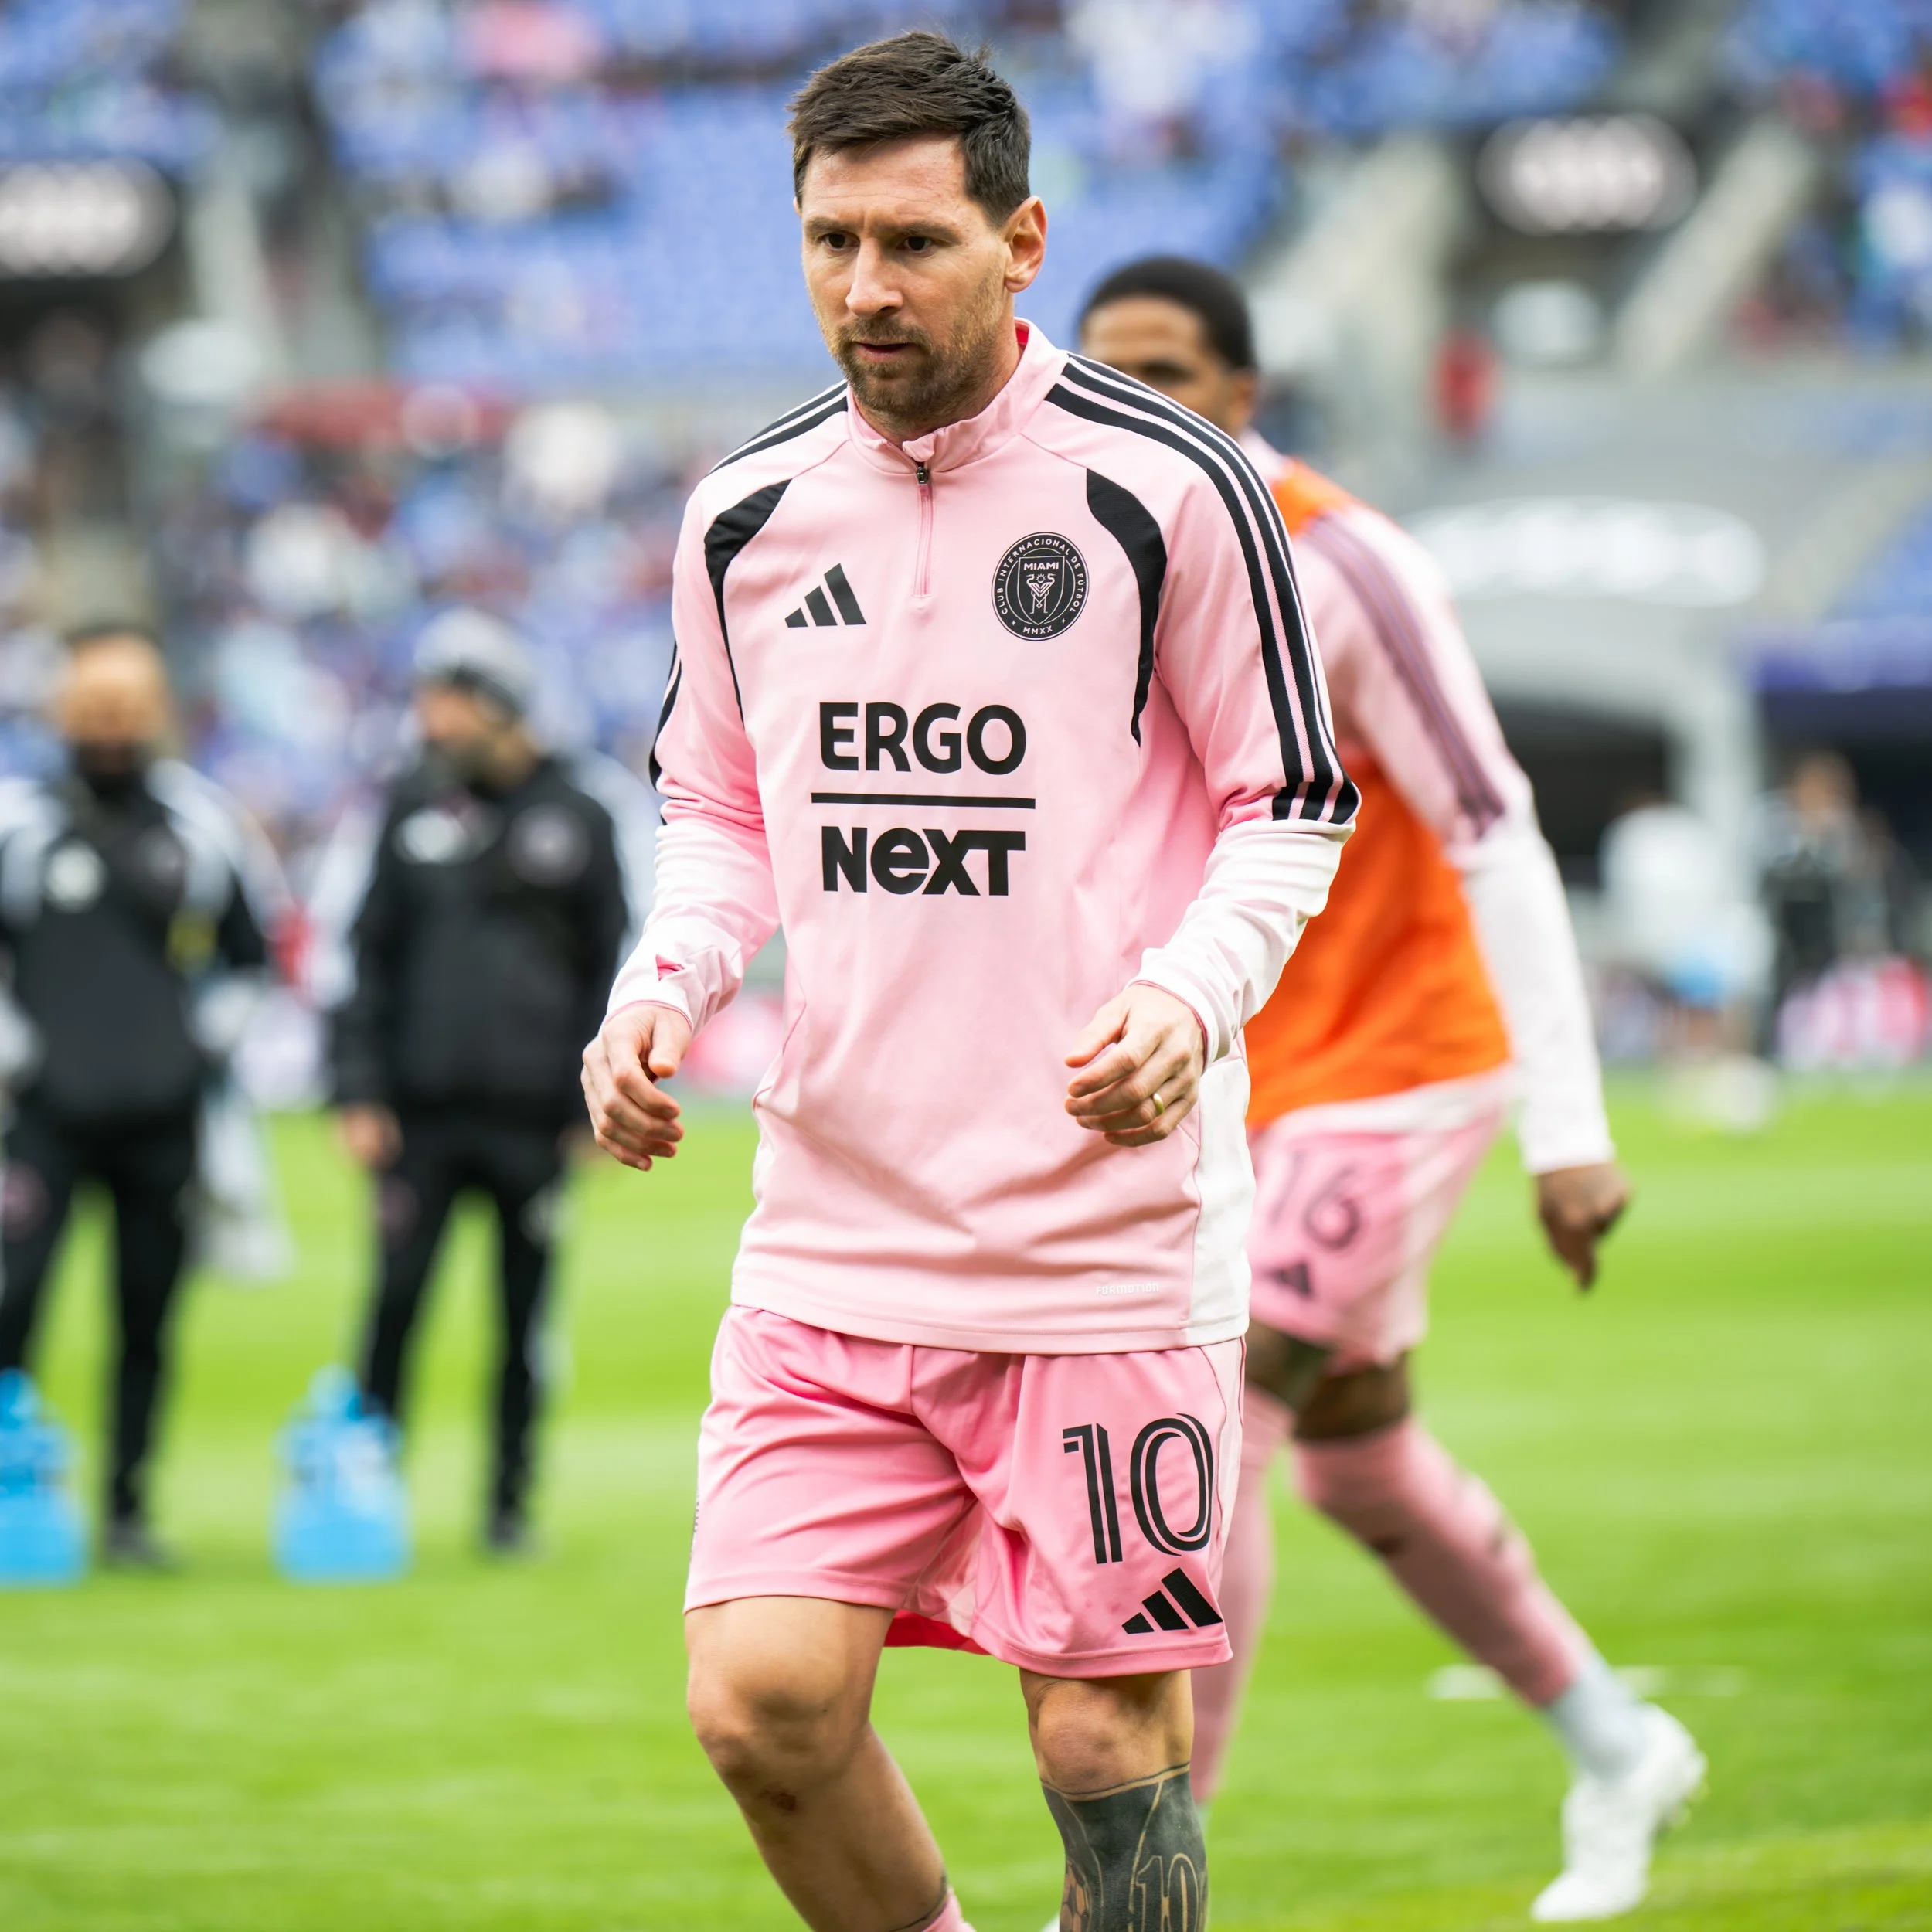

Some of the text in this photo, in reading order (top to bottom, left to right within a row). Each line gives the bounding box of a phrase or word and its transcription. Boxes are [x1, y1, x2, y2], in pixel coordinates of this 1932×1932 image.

[998, 538, 1070, 582] INTERNACIONAL
[1023, 562, 1060, 570] MIAMI
[1070, 556, 1081, 570] DE
[997, 587, 1009, 614] CLUB
[1022, 625, 1053, 634] MMXX
[819, 702, 1026, 775] ERGO
[1062, 1413, 1214, 1564] 10
[1135, 1852, 1199, 1932] 10
